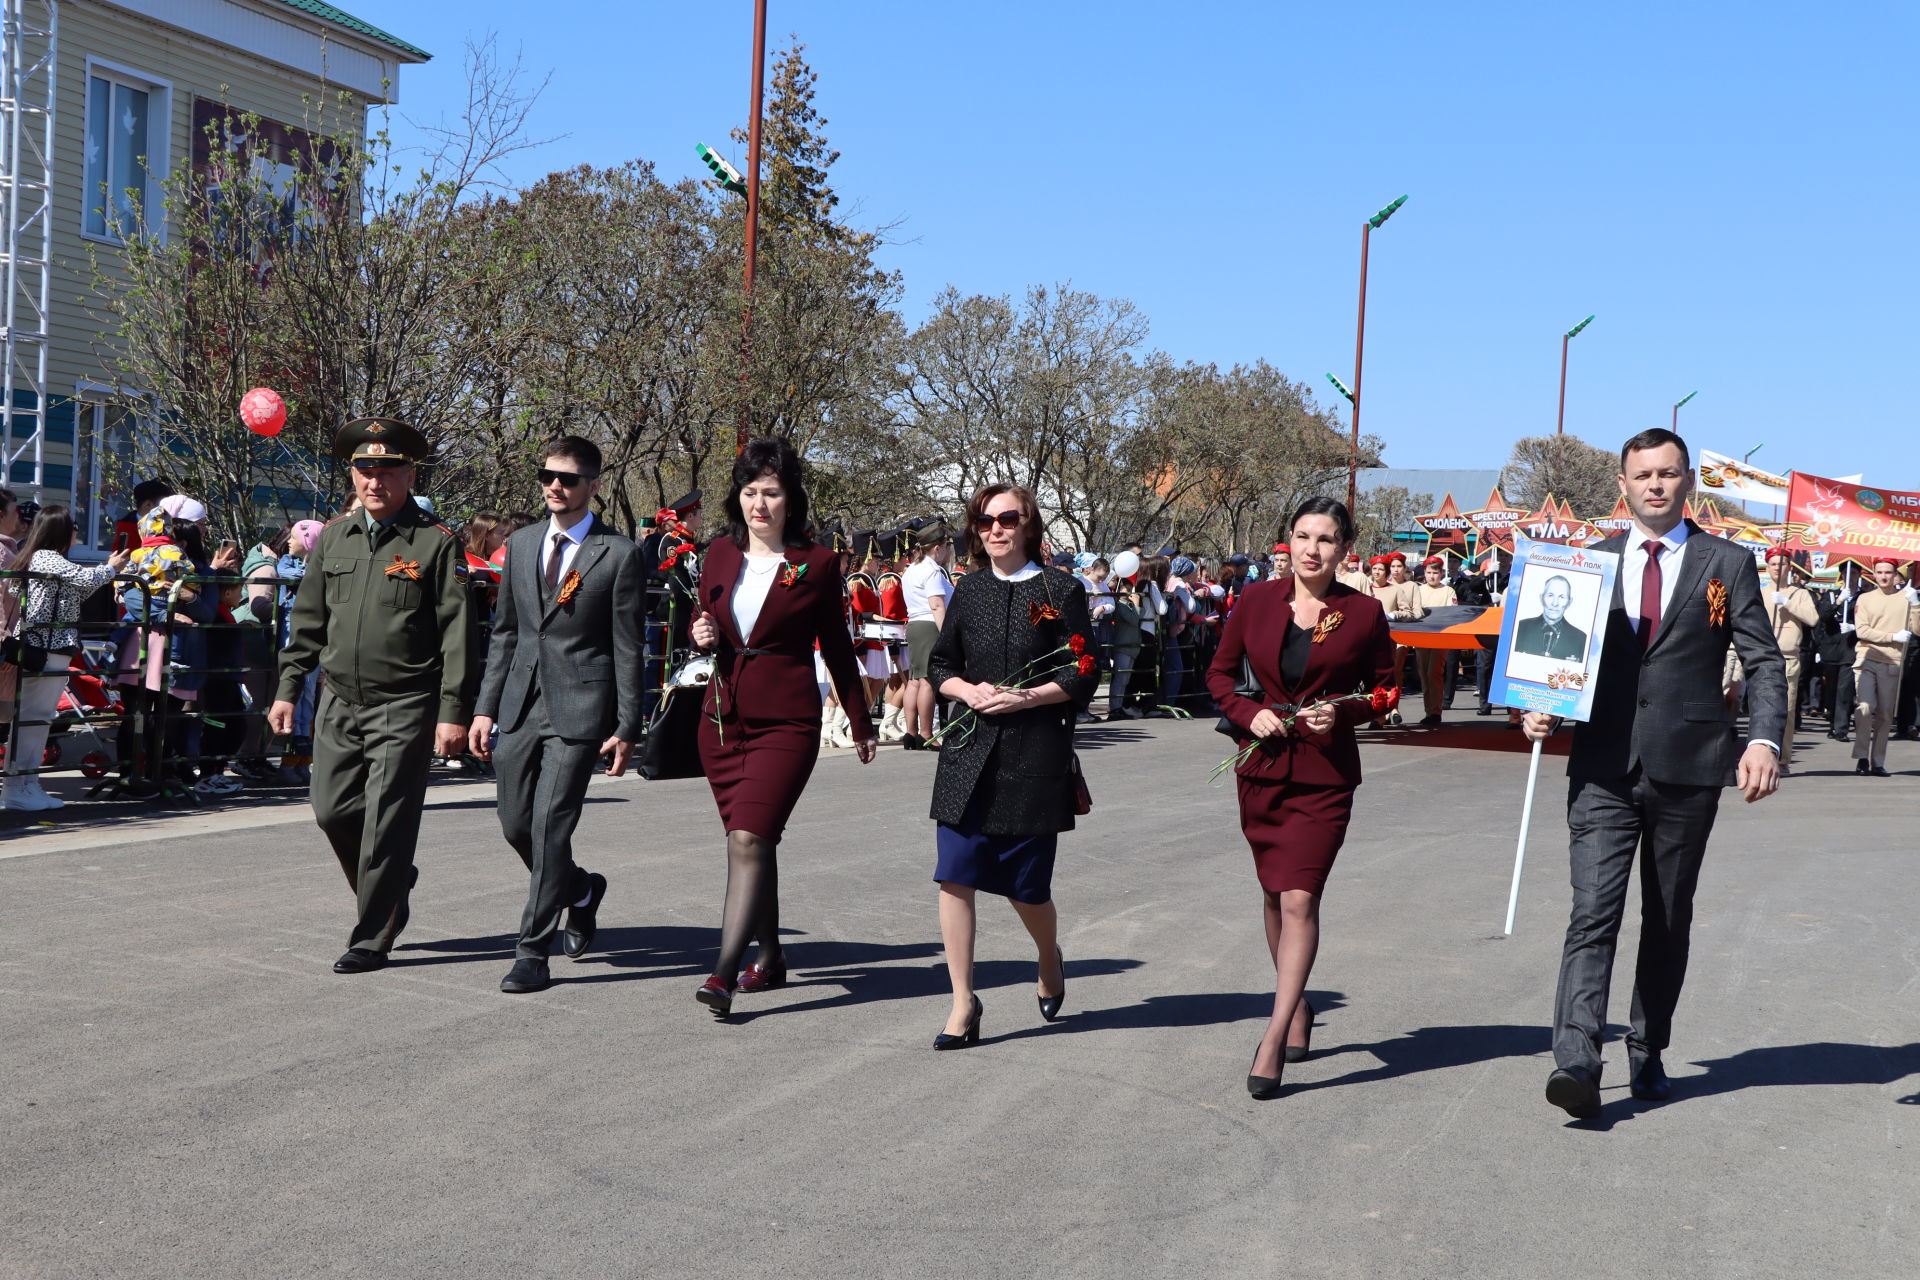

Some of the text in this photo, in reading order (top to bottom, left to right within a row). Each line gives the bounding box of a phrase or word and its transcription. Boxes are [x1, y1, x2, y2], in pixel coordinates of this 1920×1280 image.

[1890, 495, 1920, 508] МБ
[1472, 511, 1519, 522] БРЕСТСКАЯ
[1477, 520, 1514, 529] КРЕПОСТЬ
[1867, 518, 1881, 530] С
[1528, 523, 1570, 539] ТУЛА
